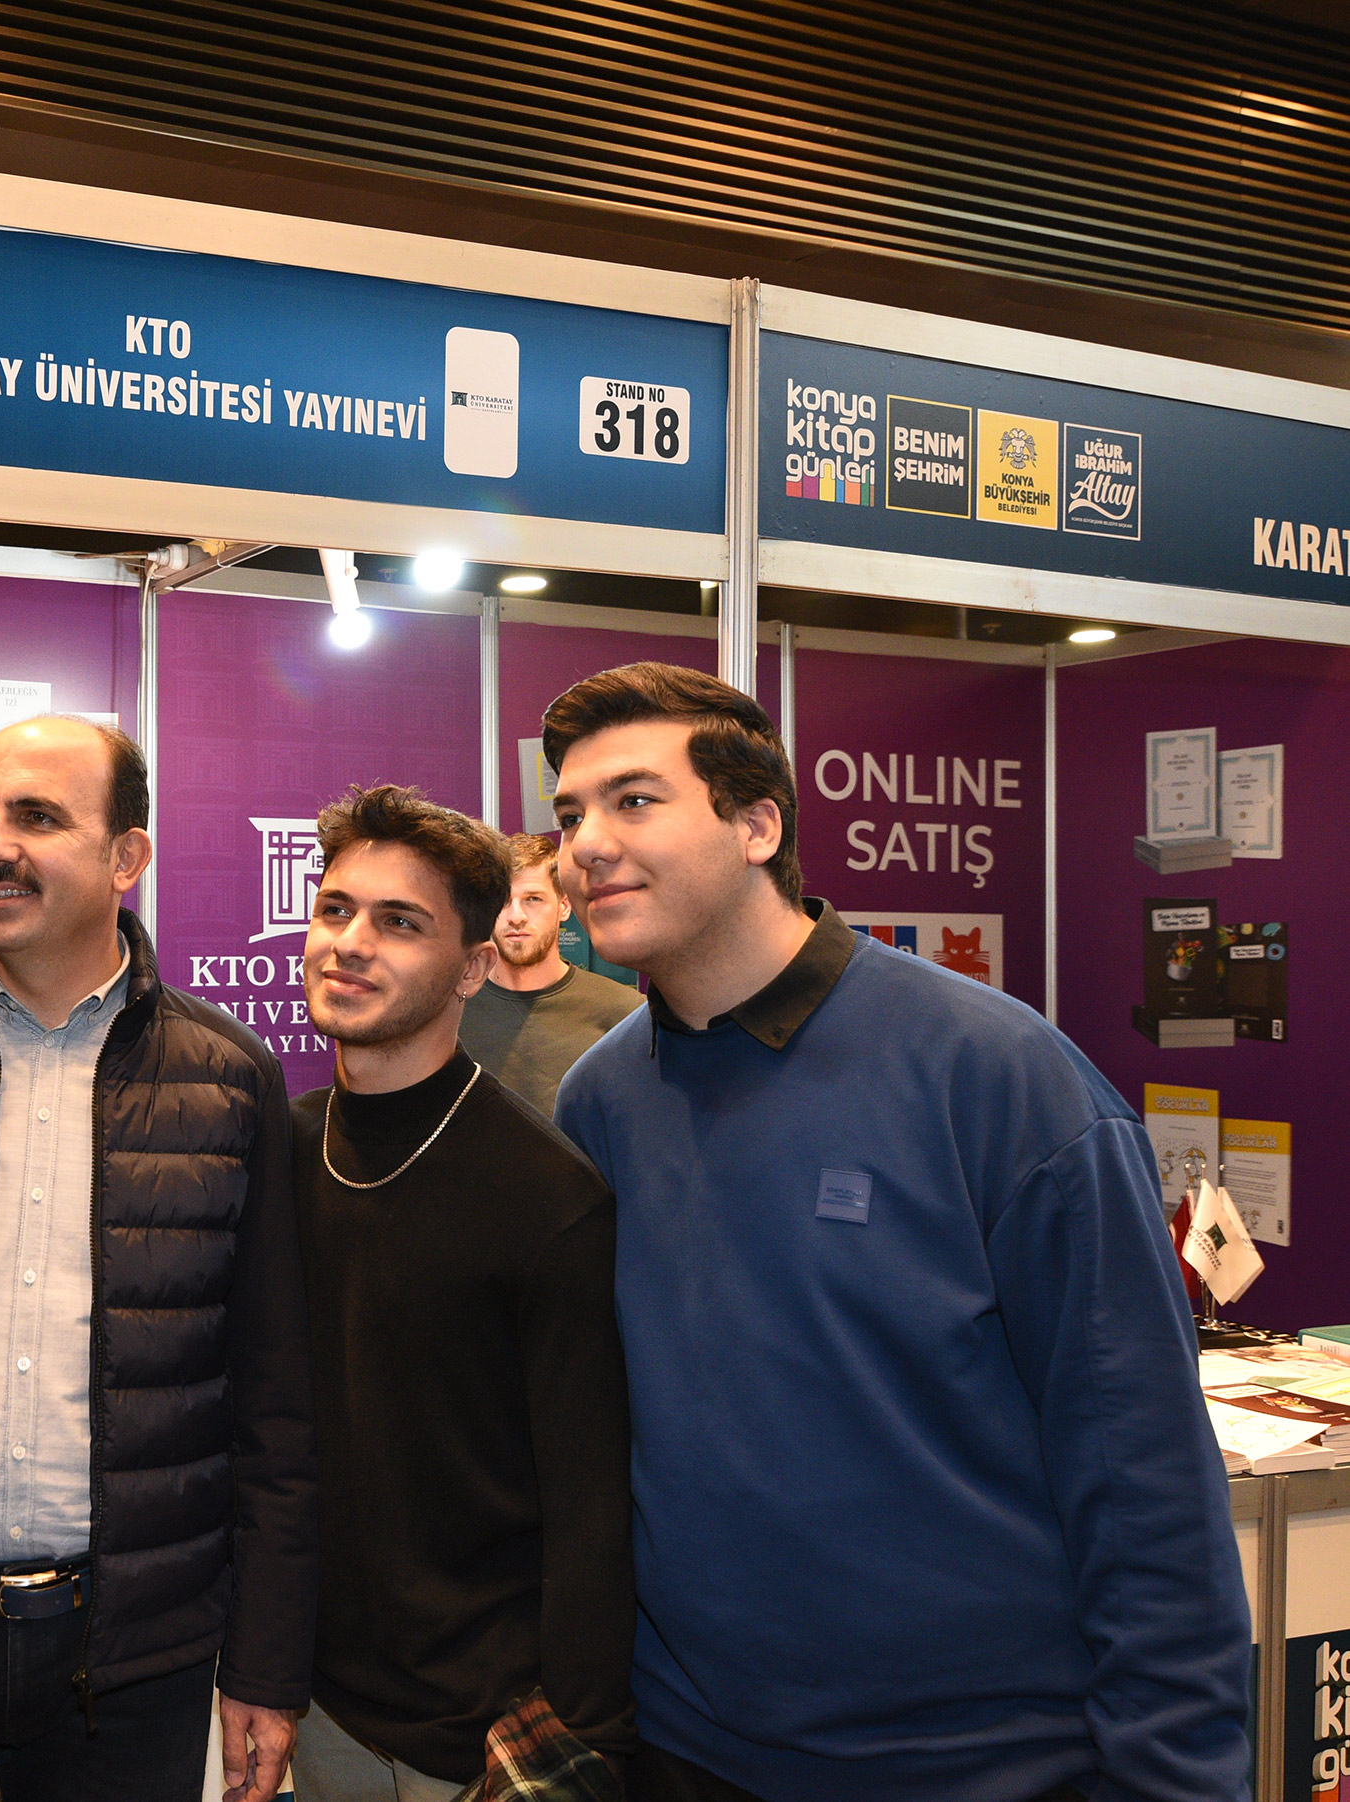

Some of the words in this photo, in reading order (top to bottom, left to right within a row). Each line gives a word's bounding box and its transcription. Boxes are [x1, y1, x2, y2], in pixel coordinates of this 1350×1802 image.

[125, 315, 191, 359] KTO
[35, 353, 272, 425] ÜNİVERSİTESİ
[283, 390, 427, 441] YAYINEVİ
[606, 382, 645, 400] STAND
[649, 387, 665, 404] NO
[787, 378, 876, 425] konya
[594, 400, 679, 459] 318
[787, 409, 875, 461] kitap
[1084, 438, 1123, 460] UĞUR
[786, 451, 875, 485] günleri
[1001, 473, 1034, 488] KONYA
[984, 484, 1050, 506] BÜYÜKŞEHİR
[998, 503, 1037, 515] BELEDİYESİ
[1068, 472, 1136, 520] Altay
[814, 749, 1022, 809] ONLINE
[846, 820, 995, 889] SATIŞ
[189, 955, 275, 986] KTO
